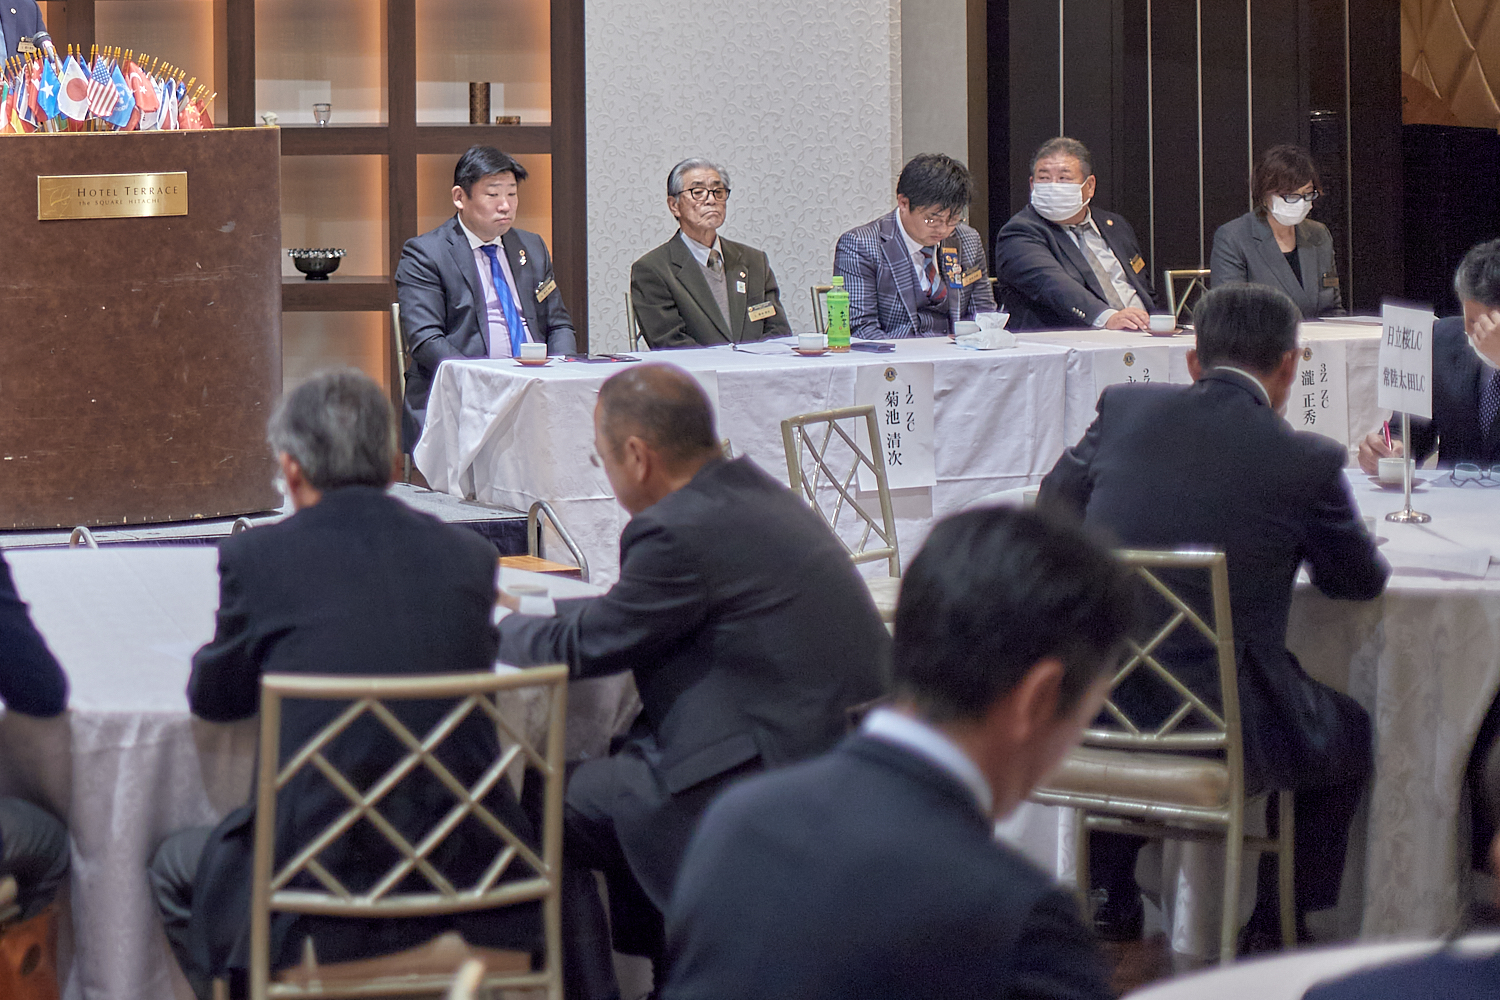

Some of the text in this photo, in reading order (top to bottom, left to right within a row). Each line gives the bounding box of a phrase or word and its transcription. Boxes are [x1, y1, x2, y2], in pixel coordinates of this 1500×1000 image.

[77, 185, 179, 198] HOTEL TERRACE
[1387, 325, 1423, 351] 日立桜LC
[1383, 366, 1426, 393] 常陸太田LC
[1302, 392, 1316, 425] 正秀
[884, 390, 903, 467] 菊池 清次
